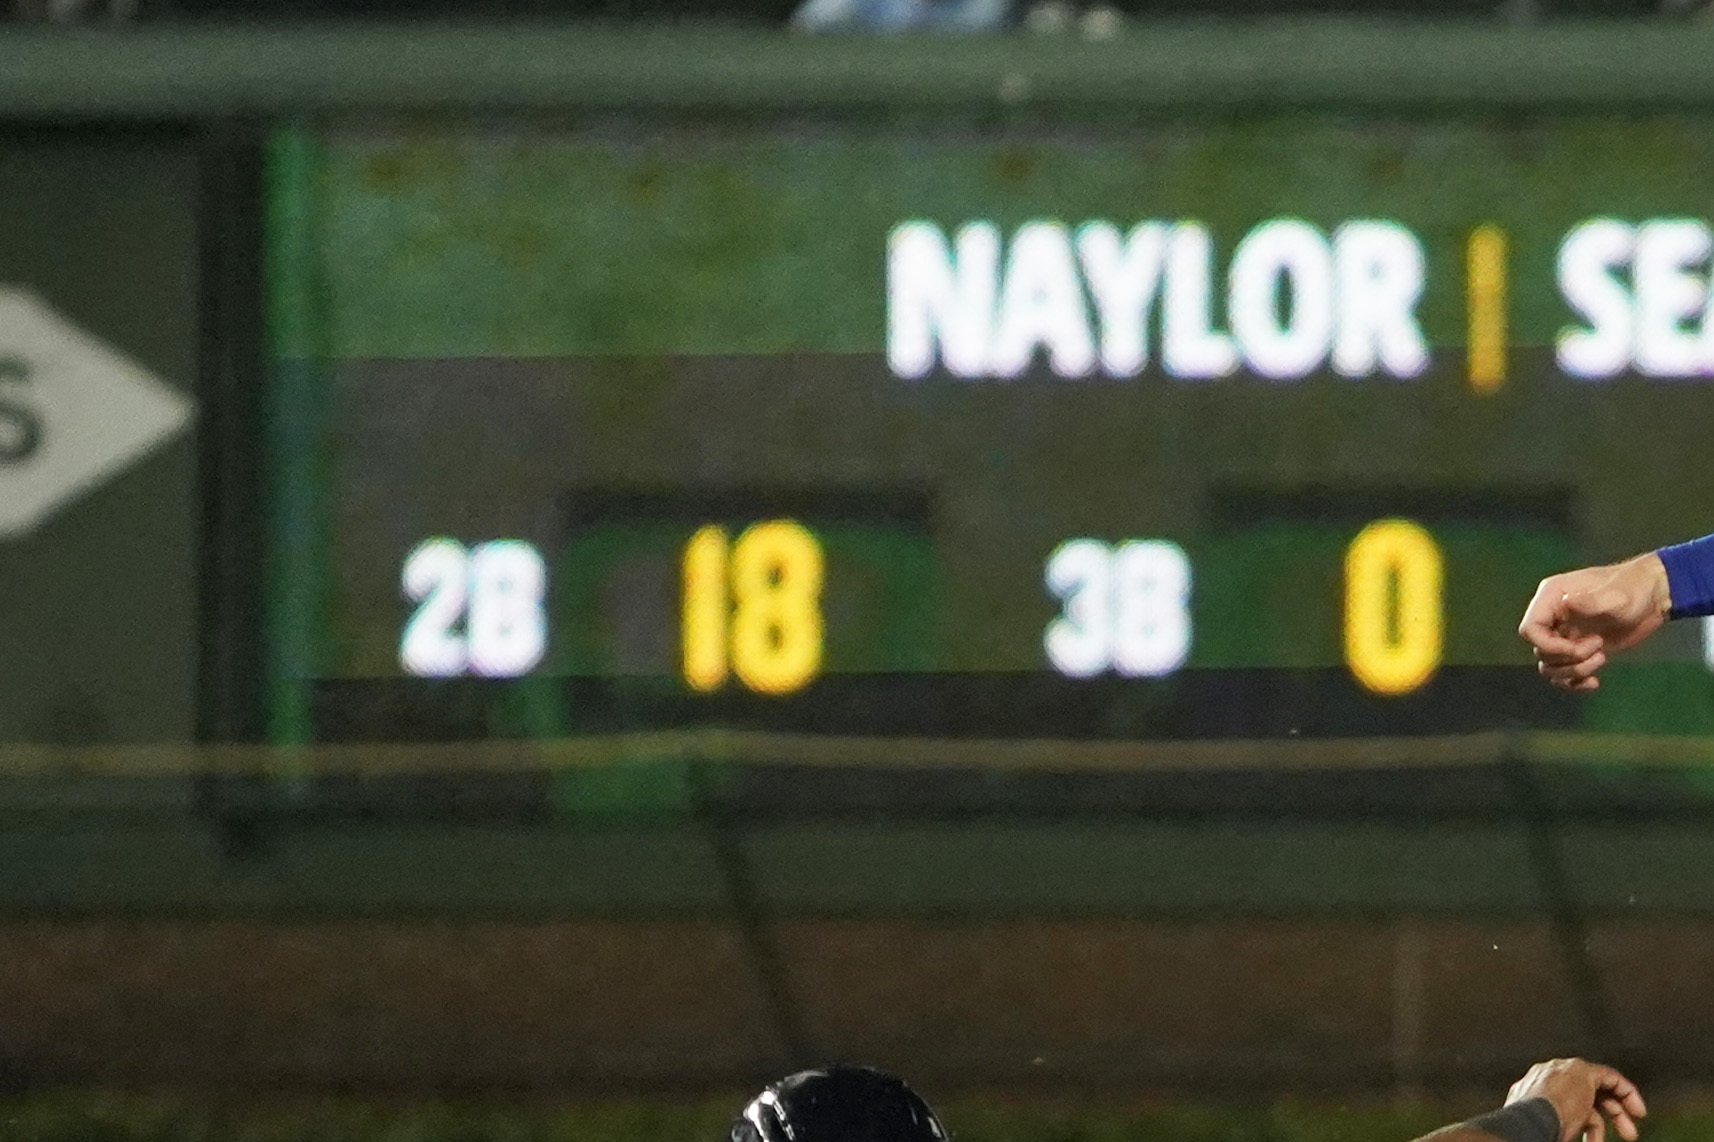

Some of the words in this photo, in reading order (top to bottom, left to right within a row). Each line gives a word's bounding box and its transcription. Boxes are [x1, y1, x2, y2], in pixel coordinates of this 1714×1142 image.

[885, 216, 1429, 378] NAYLOR
[400, 538, 546, 678] 2B
[681, 519, 824, 695] 18
[1043, 538, 1192, 678] 3B
[1343, 519, 1444, 695] 0
